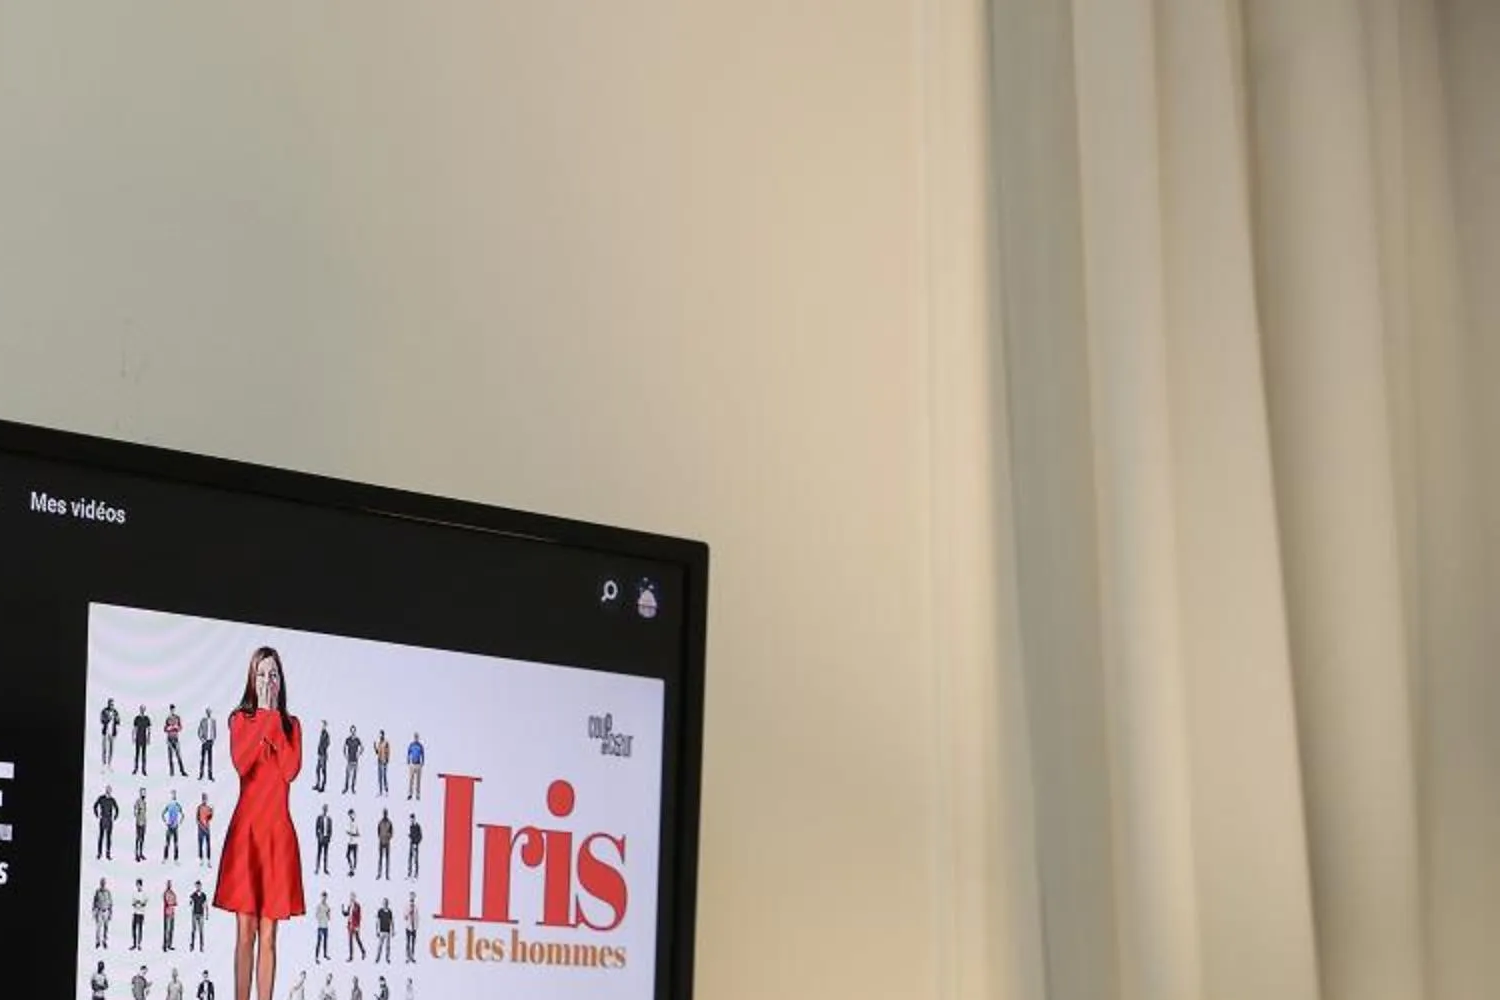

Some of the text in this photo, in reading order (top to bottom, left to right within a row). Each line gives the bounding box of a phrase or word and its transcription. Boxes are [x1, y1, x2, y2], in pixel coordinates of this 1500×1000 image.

[30, 491, 127, 524] Mes vidéos
[432, 773, 629, 932] Iris
[429, 925, 627, 969] et les hommes
